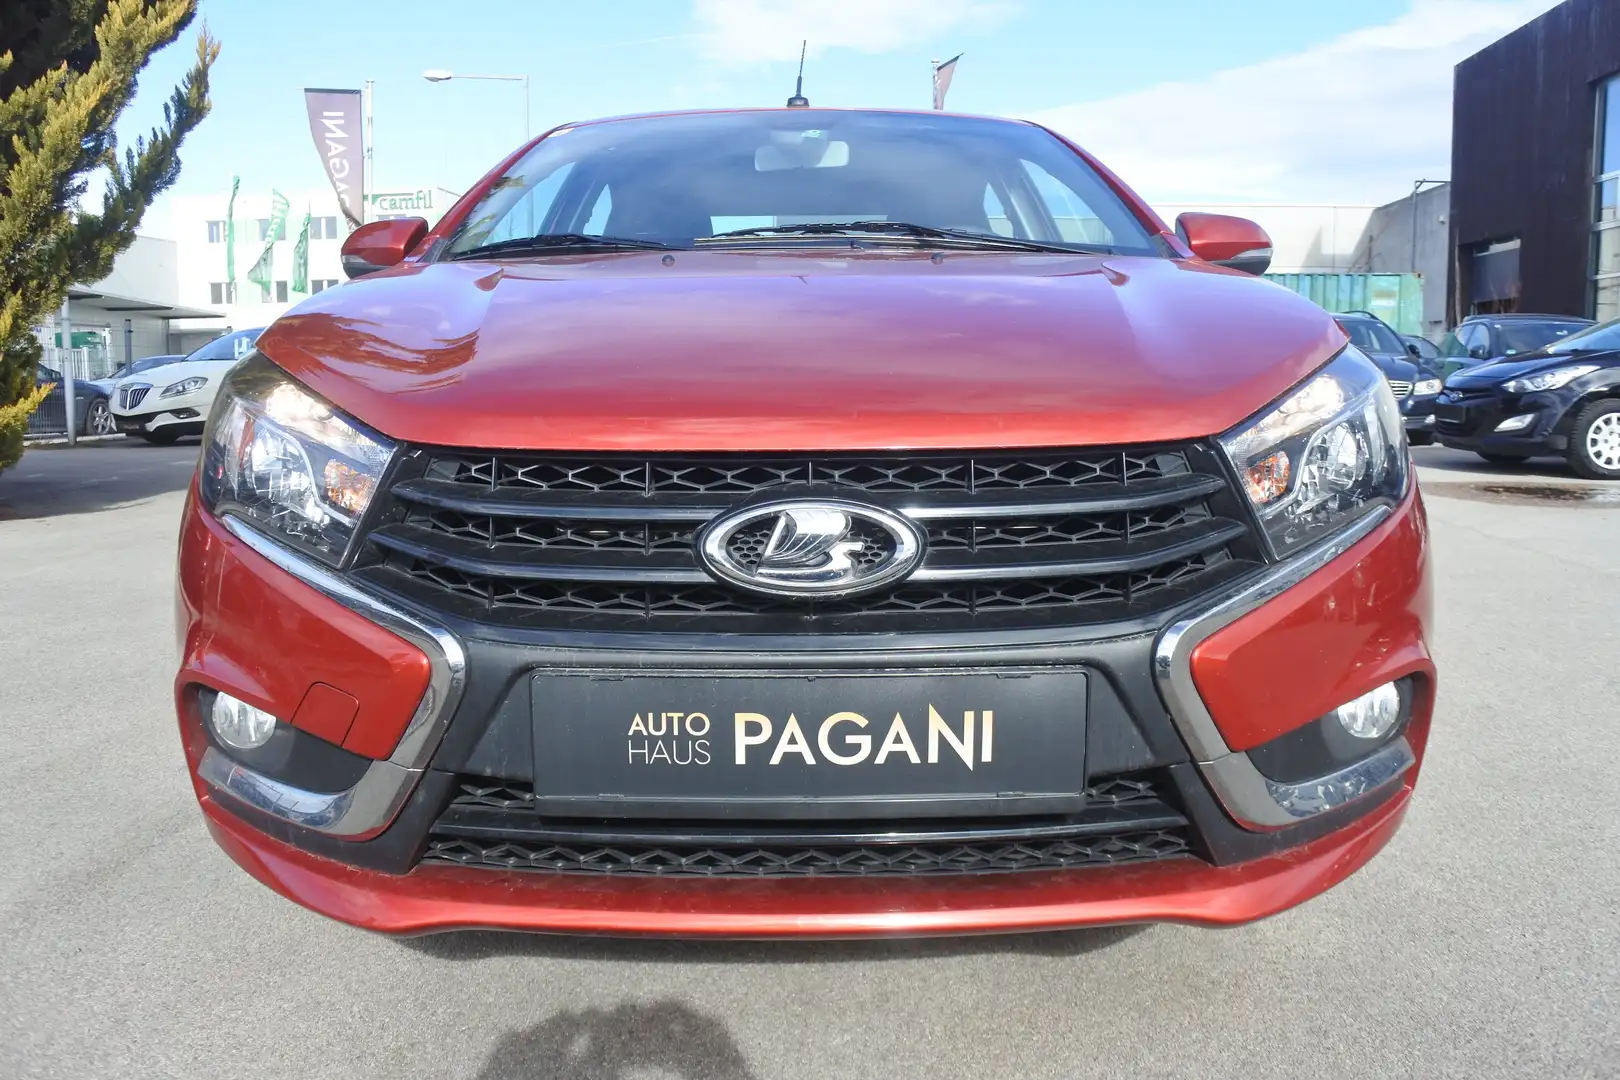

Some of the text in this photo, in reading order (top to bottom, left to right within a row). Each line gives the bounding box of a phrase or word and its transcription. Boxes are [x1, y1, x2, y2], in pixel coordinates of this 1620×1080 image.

[379, 190, 433, 210] camfil
[628, 712, 710, 736] AUTO
[734, 703, 993, 771] PAGANI
[628, 740, 711, 765] HAUS
